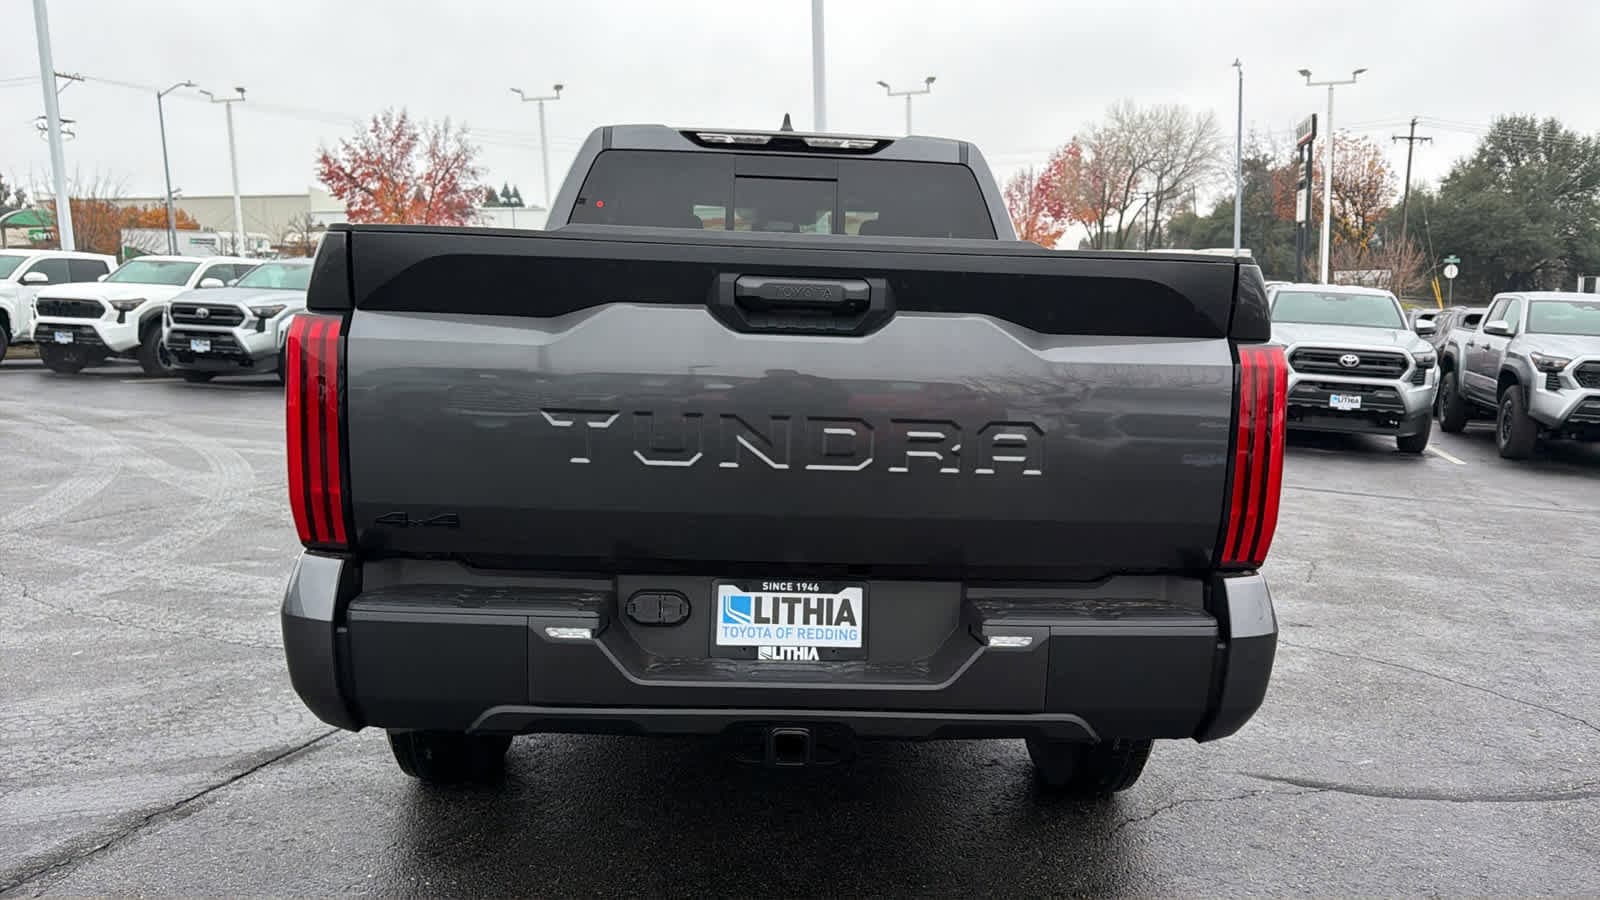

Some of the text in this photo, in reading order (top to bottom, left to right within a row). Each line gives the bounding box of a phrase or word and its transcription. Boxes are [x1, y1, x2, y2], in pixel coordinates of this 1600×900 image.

[540, 408, 1045, 476] TUNDRA
[762, 581, 820, 592] SINCE 1946
[754, 596, 857, 626] LITHIA
[722, 626, 858, 641] TOYOTA OF REDDING
[772, 646, 820, 661] LITHIA
